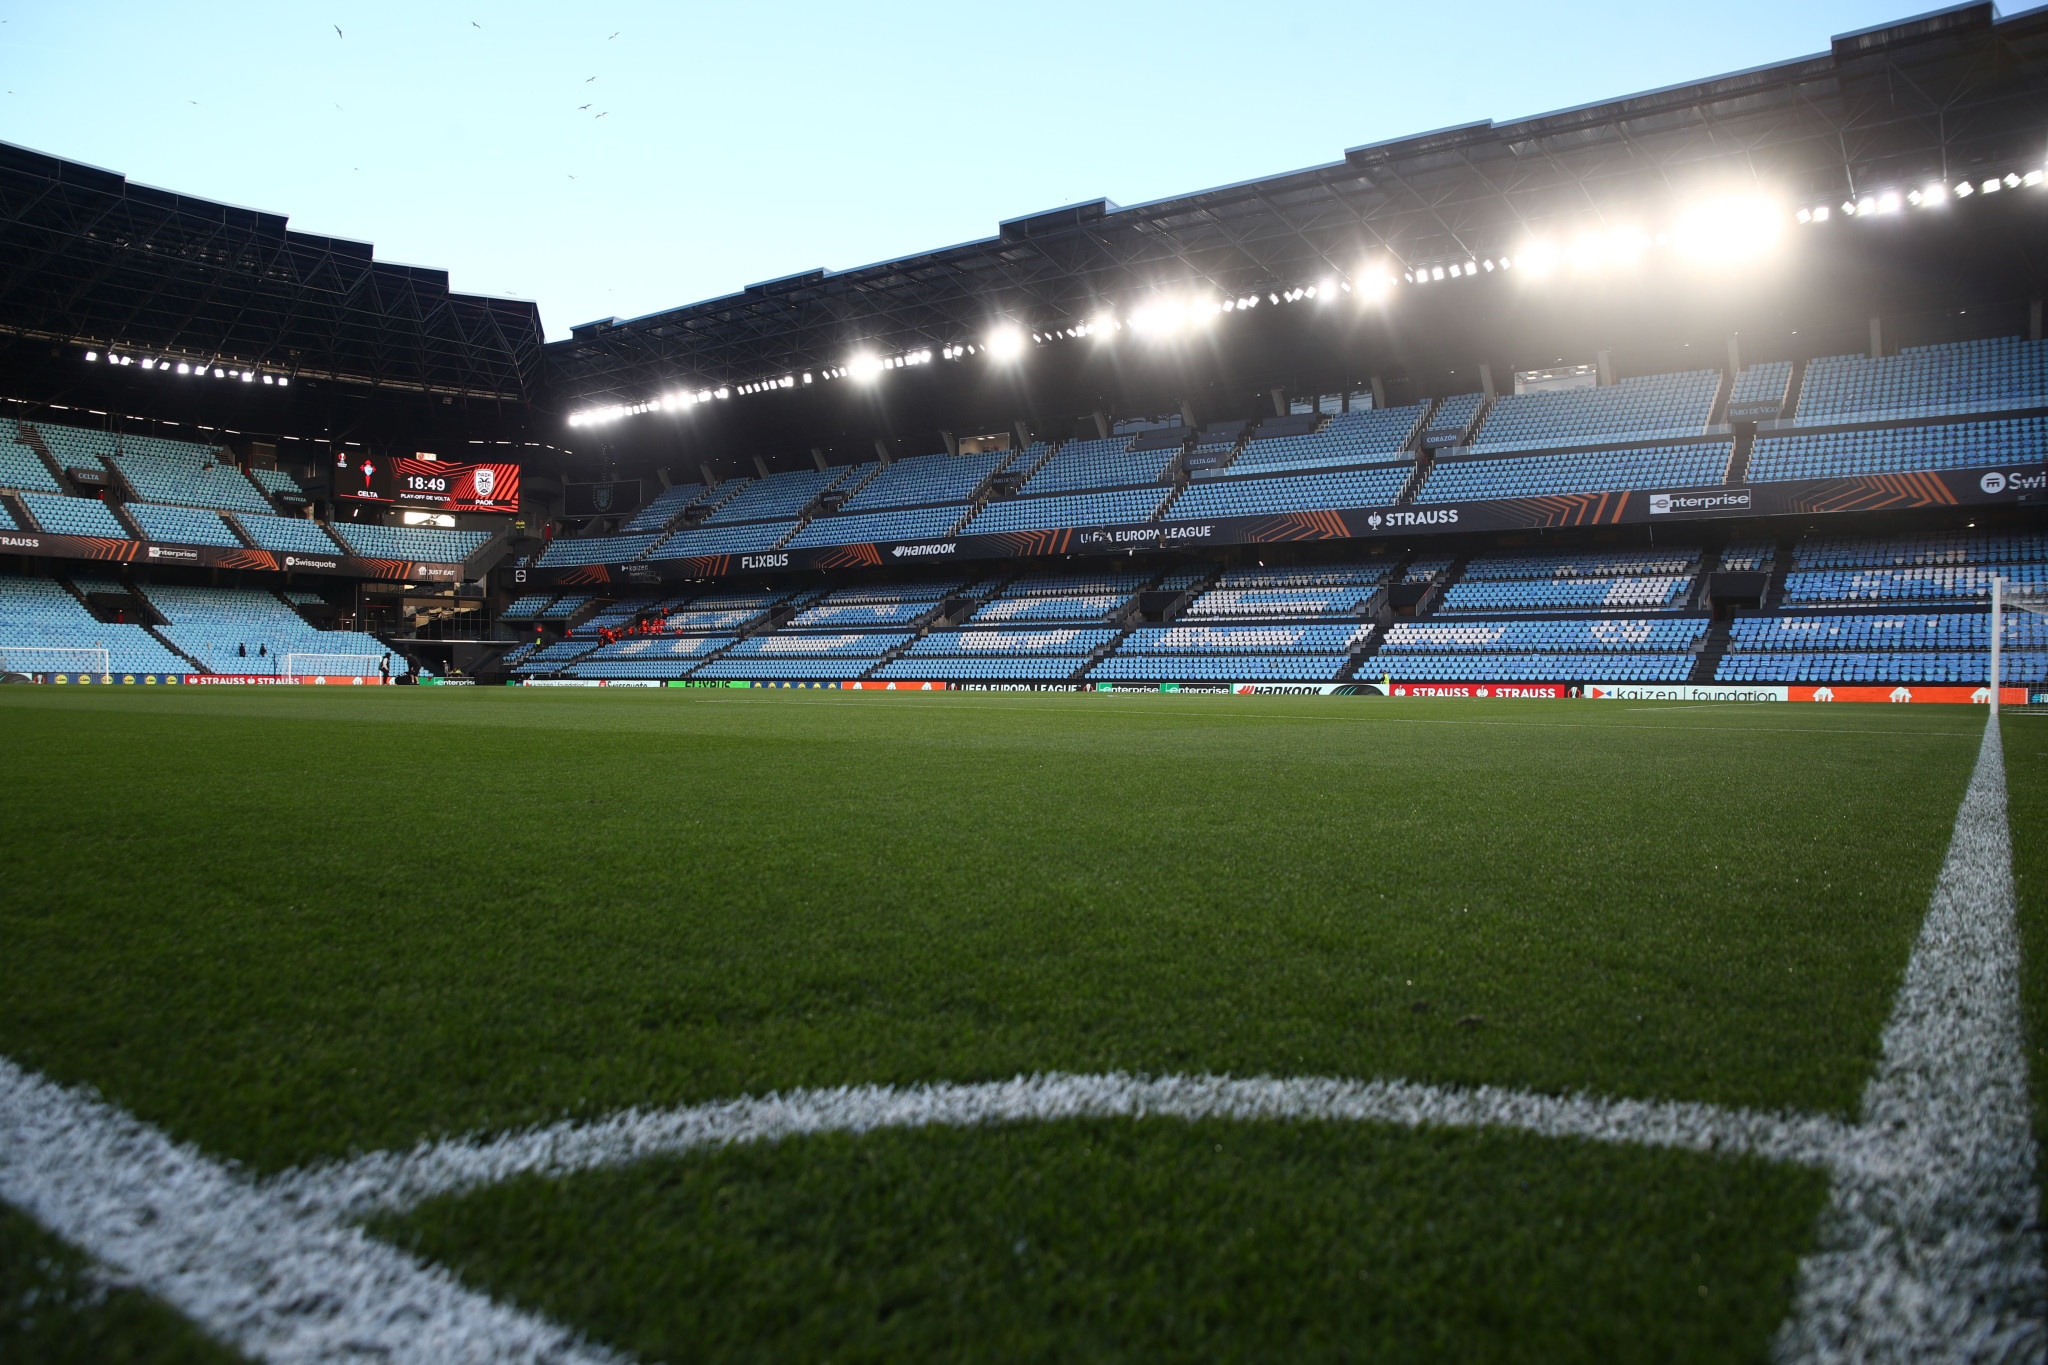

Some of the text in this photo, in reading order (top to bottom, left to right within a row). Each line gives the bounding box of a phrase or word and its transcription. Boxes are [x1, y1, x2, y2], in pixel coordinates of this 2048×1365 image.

[1426, 433, 1457, 443] CORAZÓN
[78, 472, 100, 481] CELTA
[407, 476, 446, 491] 18:49
[357, 490, 378, 498] CELTA
[1655, 493, 1749, 509] enterprise
[1385, 509, 1458, 526] STRAUSS
[1116, 528, 1160, 542] EUROPA
[1164, 525, 1212, 539] LEAGUE
[151, 549, 197, 558] enterprise
[295, 557, 337, 569] Swissquote
[200, 677, 300, 685] STRAUSS STRAUSS
[1102, 685, 1159, 693] enterprise
[1169, 686, 1229, 694] enterprise
[1412, 687, 1556, 698] STRAUSS STRAUSS
[1617, 687, 1778, 701] kaizen foundation
